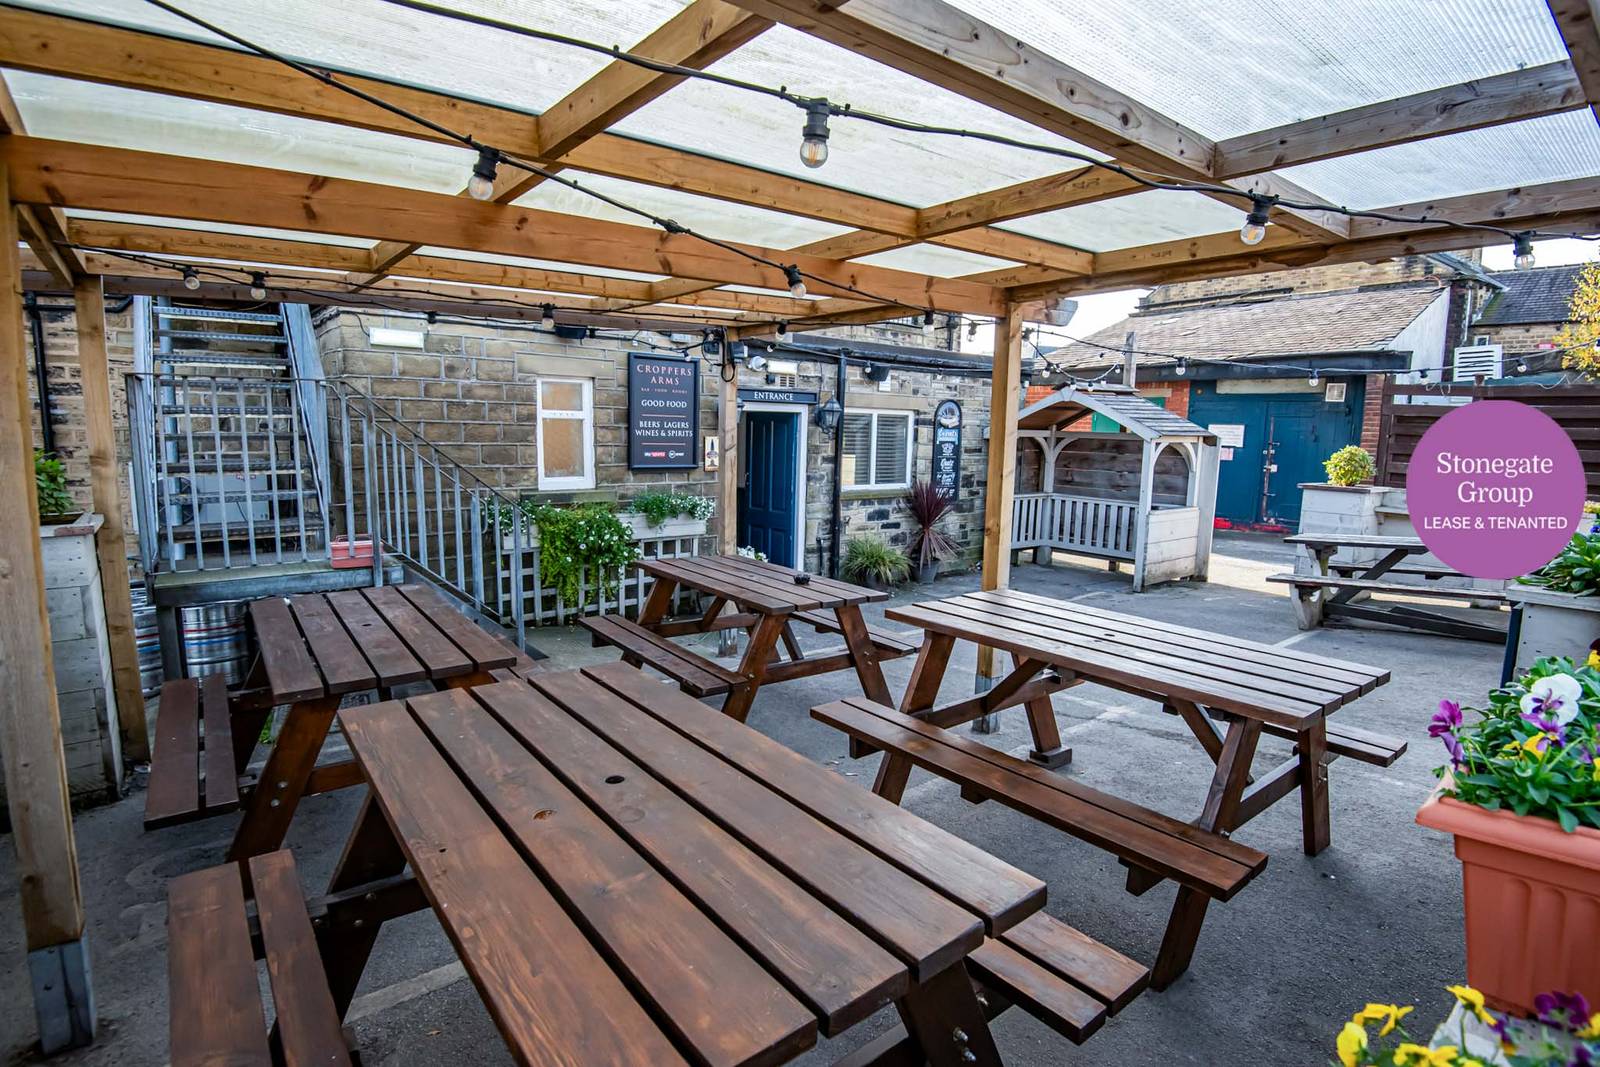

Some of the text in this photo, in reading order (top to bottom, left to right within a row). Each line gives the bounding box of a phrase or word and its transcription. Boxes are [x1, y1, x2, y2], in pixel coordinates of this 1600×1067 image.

[637, 364, 692, 376] CROPPERS
[650, 376, 680, 386] ARMS
[754, 391, 794, 401] ENTRANCE
[641, 399, 687, 408] GOOD FOOD
[639, 420, 689, 429] BEERS LAGERS
[635, 429, 659, 437] WINES
